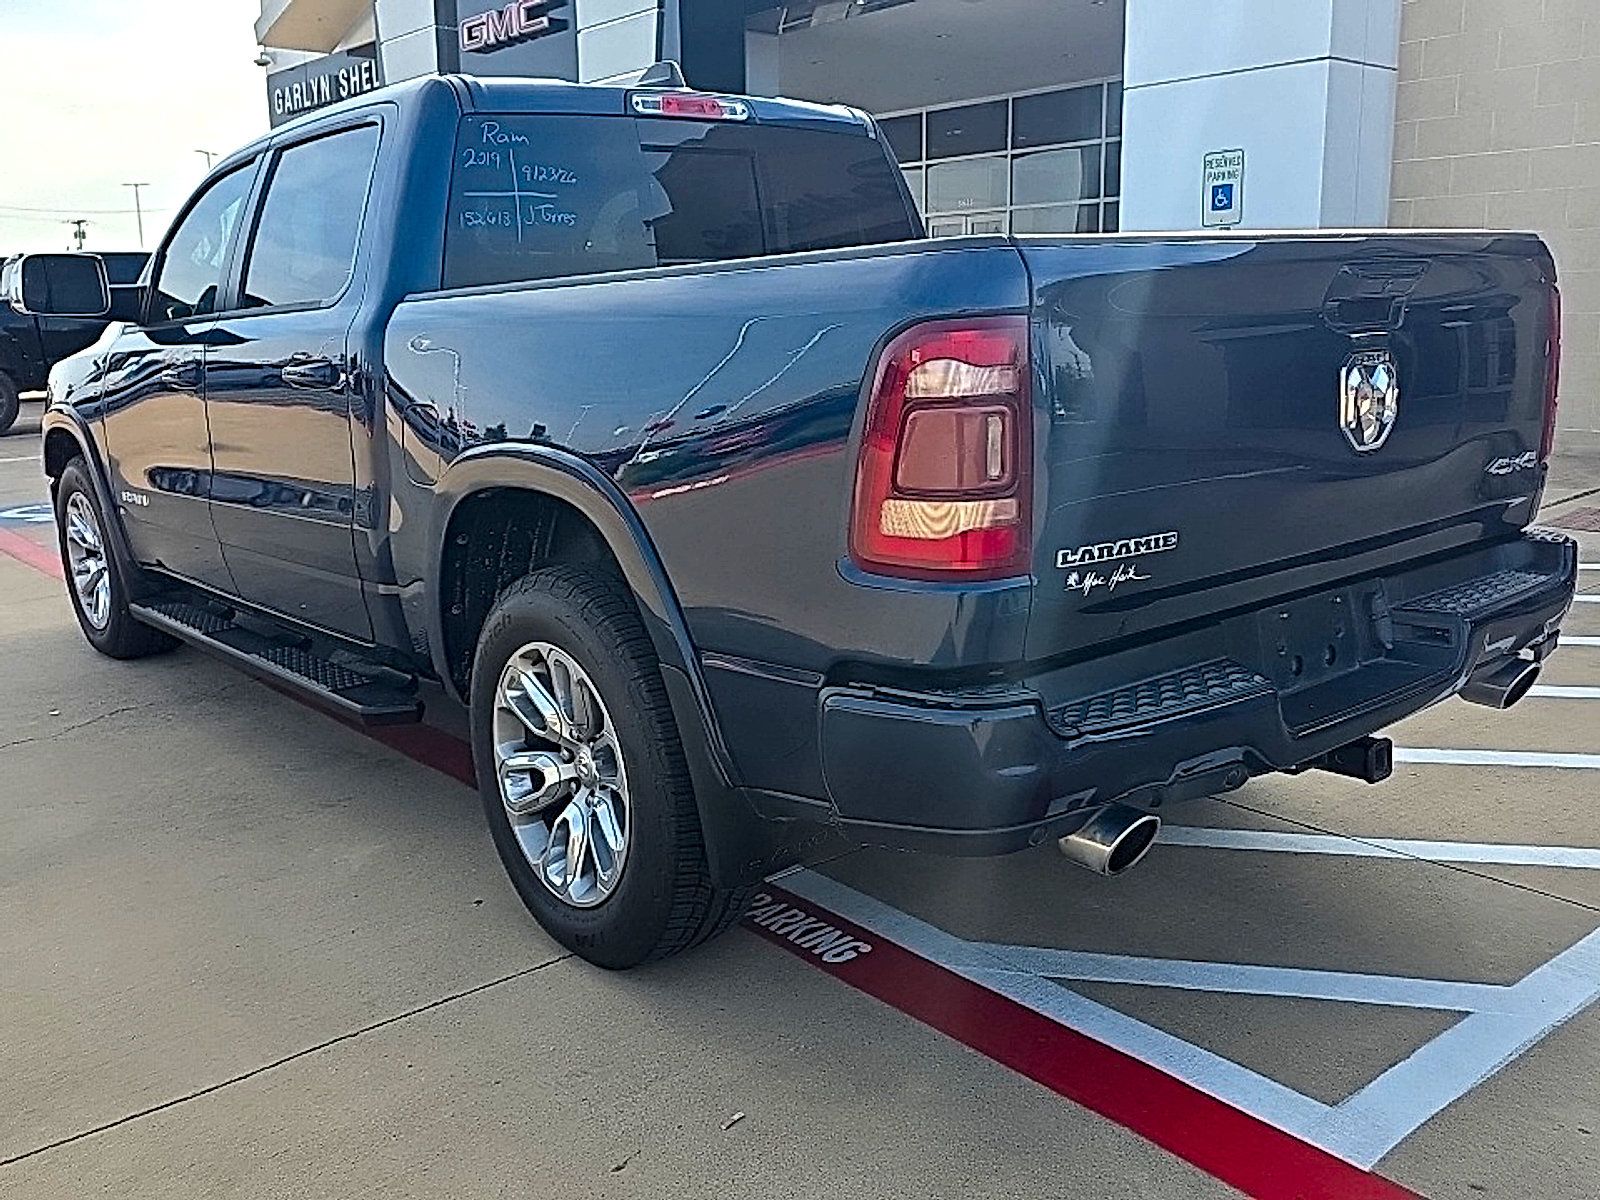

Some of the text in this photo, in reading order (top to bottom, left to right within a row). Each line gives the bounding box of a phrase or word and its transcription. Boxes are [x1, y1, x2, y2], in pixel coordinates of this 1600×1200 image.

[460, 0, 549, 53] GMC
[273, 73, 331, 115] GARLYN
[481, 121, 530, 146] Ram
[463, 149, 501, 170] 2019
[1056, 531, 1178, 568] LARAMIE
[744, 893, 873, 963] PARKING
